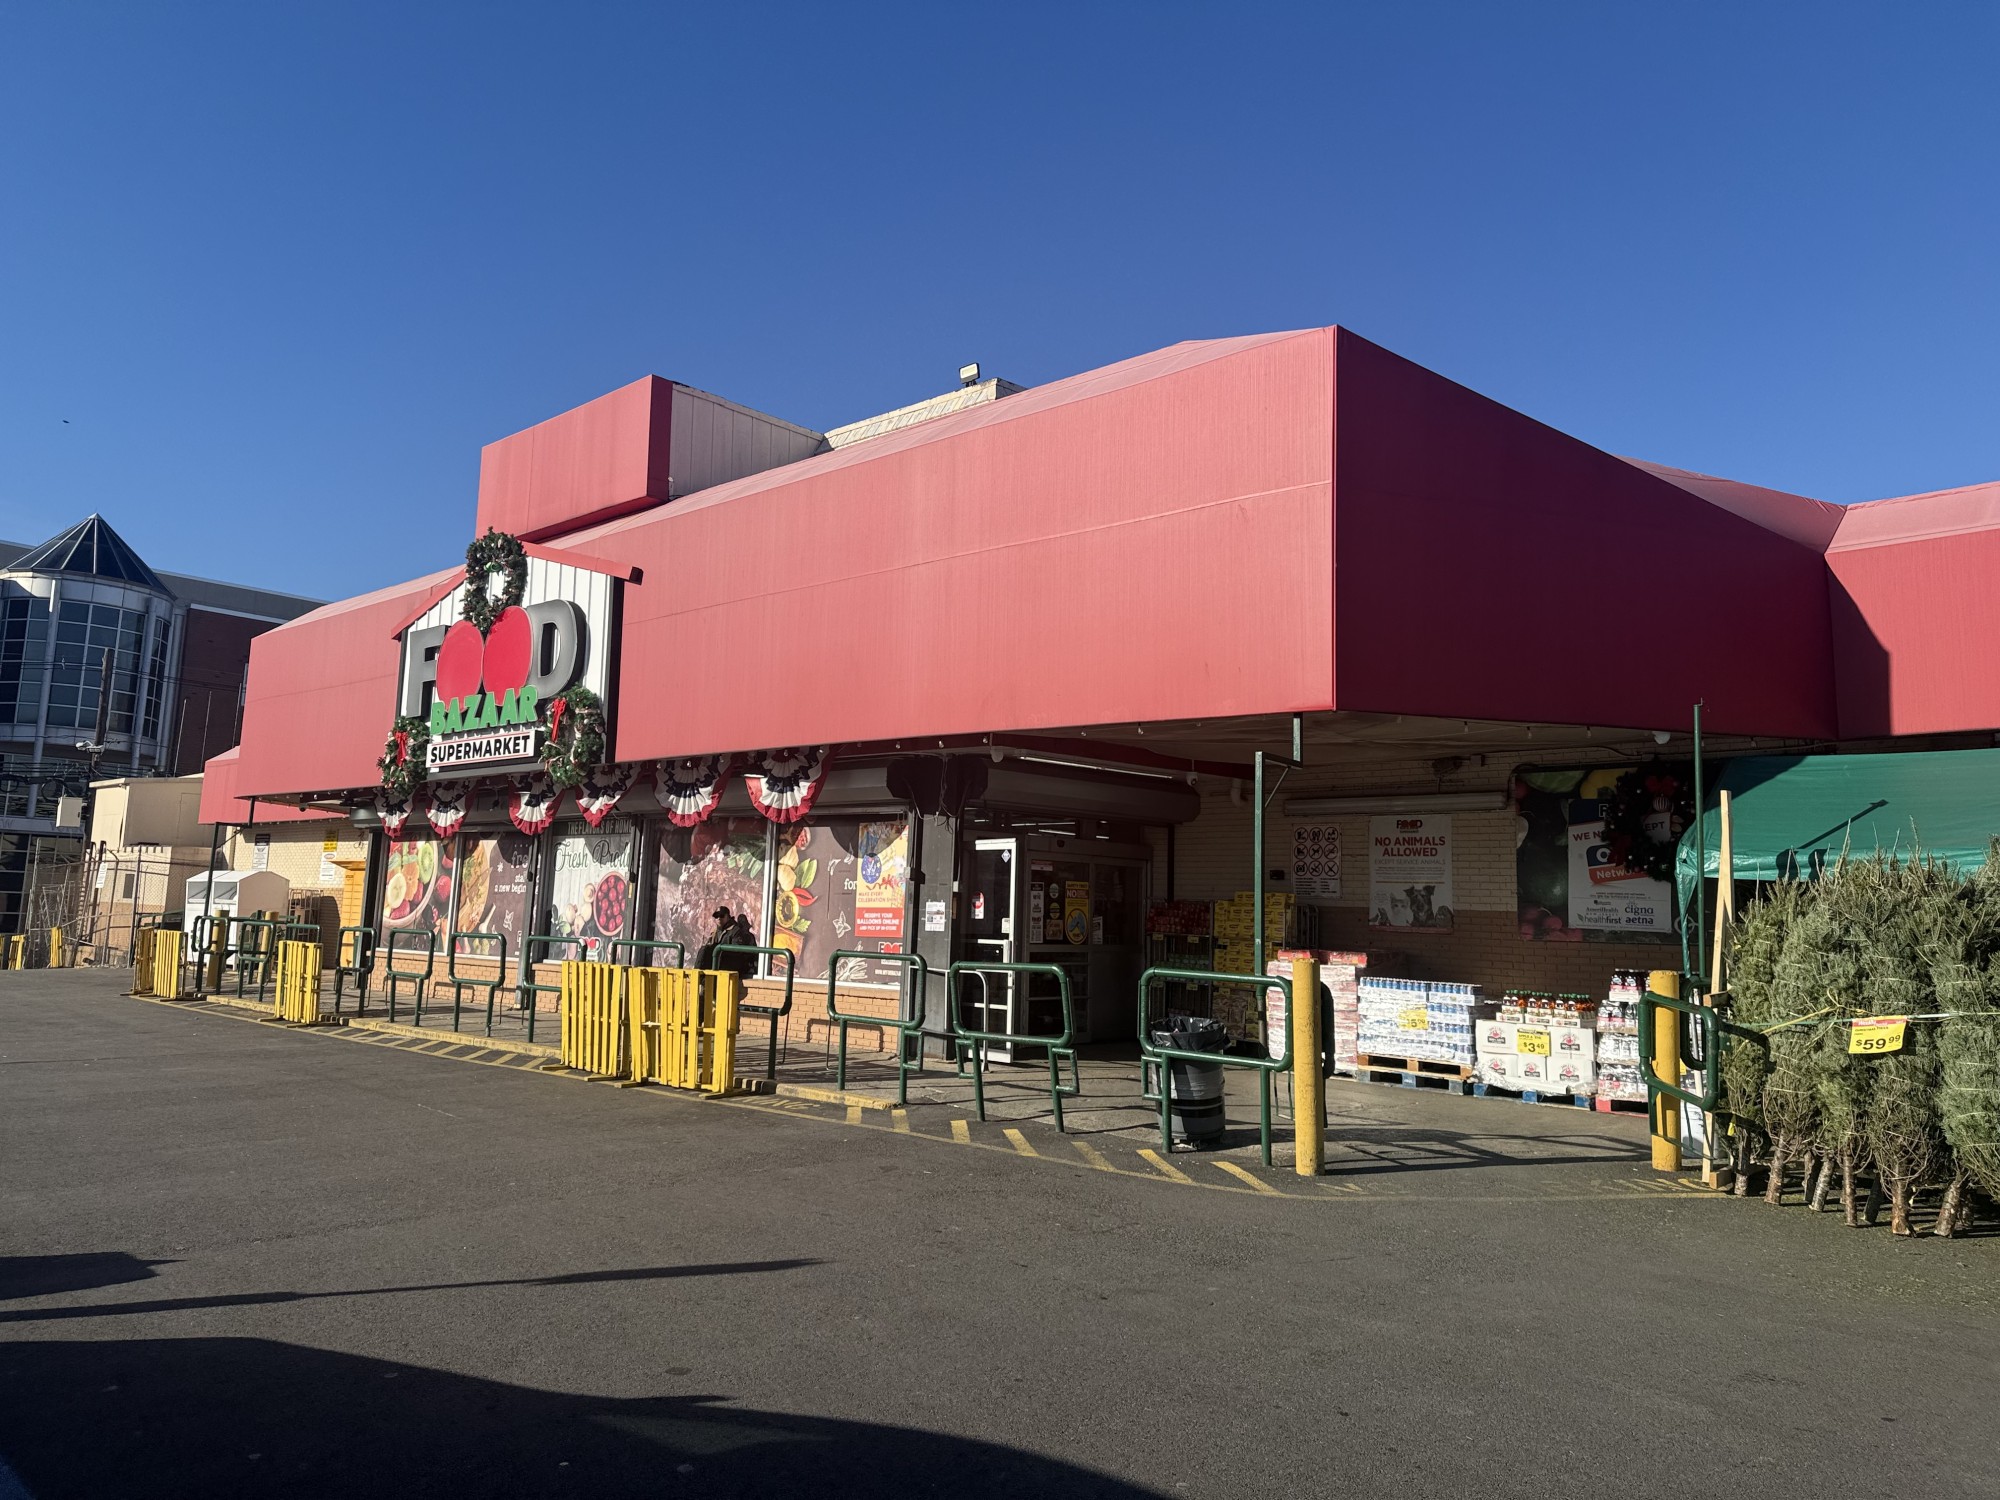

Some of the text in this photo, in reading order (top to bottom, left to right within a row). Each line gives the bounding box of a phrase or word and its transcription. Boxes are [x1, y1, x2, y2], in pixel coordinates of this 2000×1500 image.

[406, 599, 588, 718] FOOD
[430, 684, 538, 736] BAZAAR
[430, 735, 530, 764] SUPERMARKET
[1375, 836, 1446, 846] NO ANIMALS
[1573, 832, 1590, 842] WE
[554, 838, 631, 872] Fresh Prod
[1382, 848, 1438, 856] ALLOWED
[1624, 905, 1654, 916] cigna
